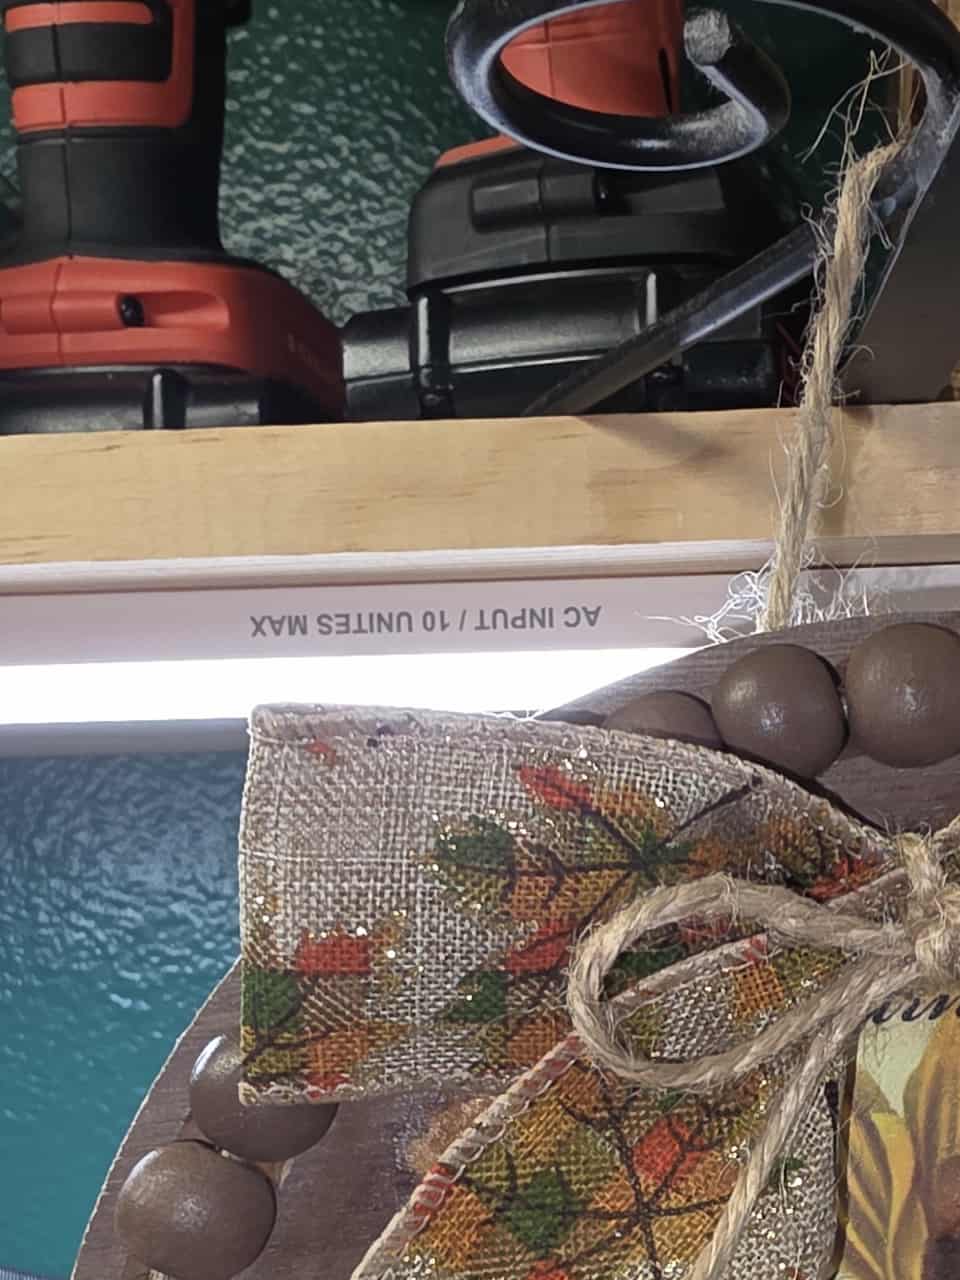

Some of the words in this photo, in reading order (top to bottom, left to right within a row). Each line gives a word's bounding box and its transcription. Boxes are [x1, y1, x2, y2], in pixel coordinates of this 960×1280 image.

[250, 615, 308, 637] MAX
[317, 610, 413, 635] UNITES
[422, 609, 450, 633] 10
[474, 607, 554, 630] INPUT
[564, 606, 602, 627] AC
